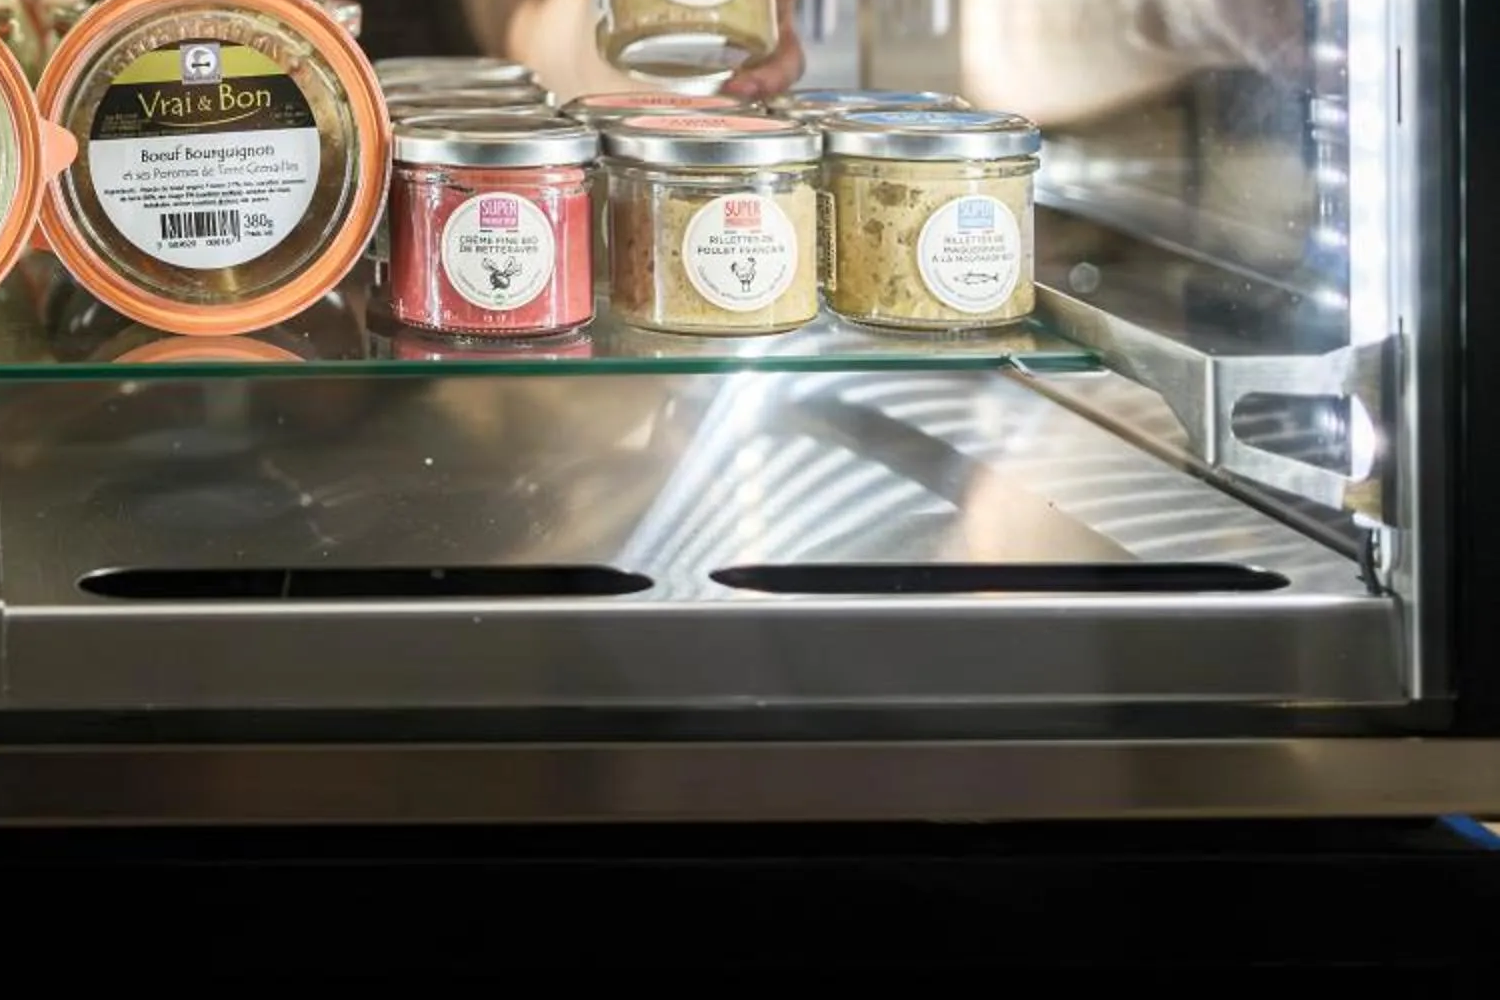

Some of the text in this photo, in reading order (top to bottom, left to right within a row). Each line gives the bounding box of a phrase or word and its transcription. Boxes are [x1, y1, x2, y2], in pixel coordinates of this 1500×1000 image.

[137, 83, 271, 119] Vrai & Bon
[185, 144, 276, 164] Bourguignon
[481, 199, 518, 218] SUPER
[724, 199, 762, 218] SUPER
[243, 212, 274, 229] 380g
